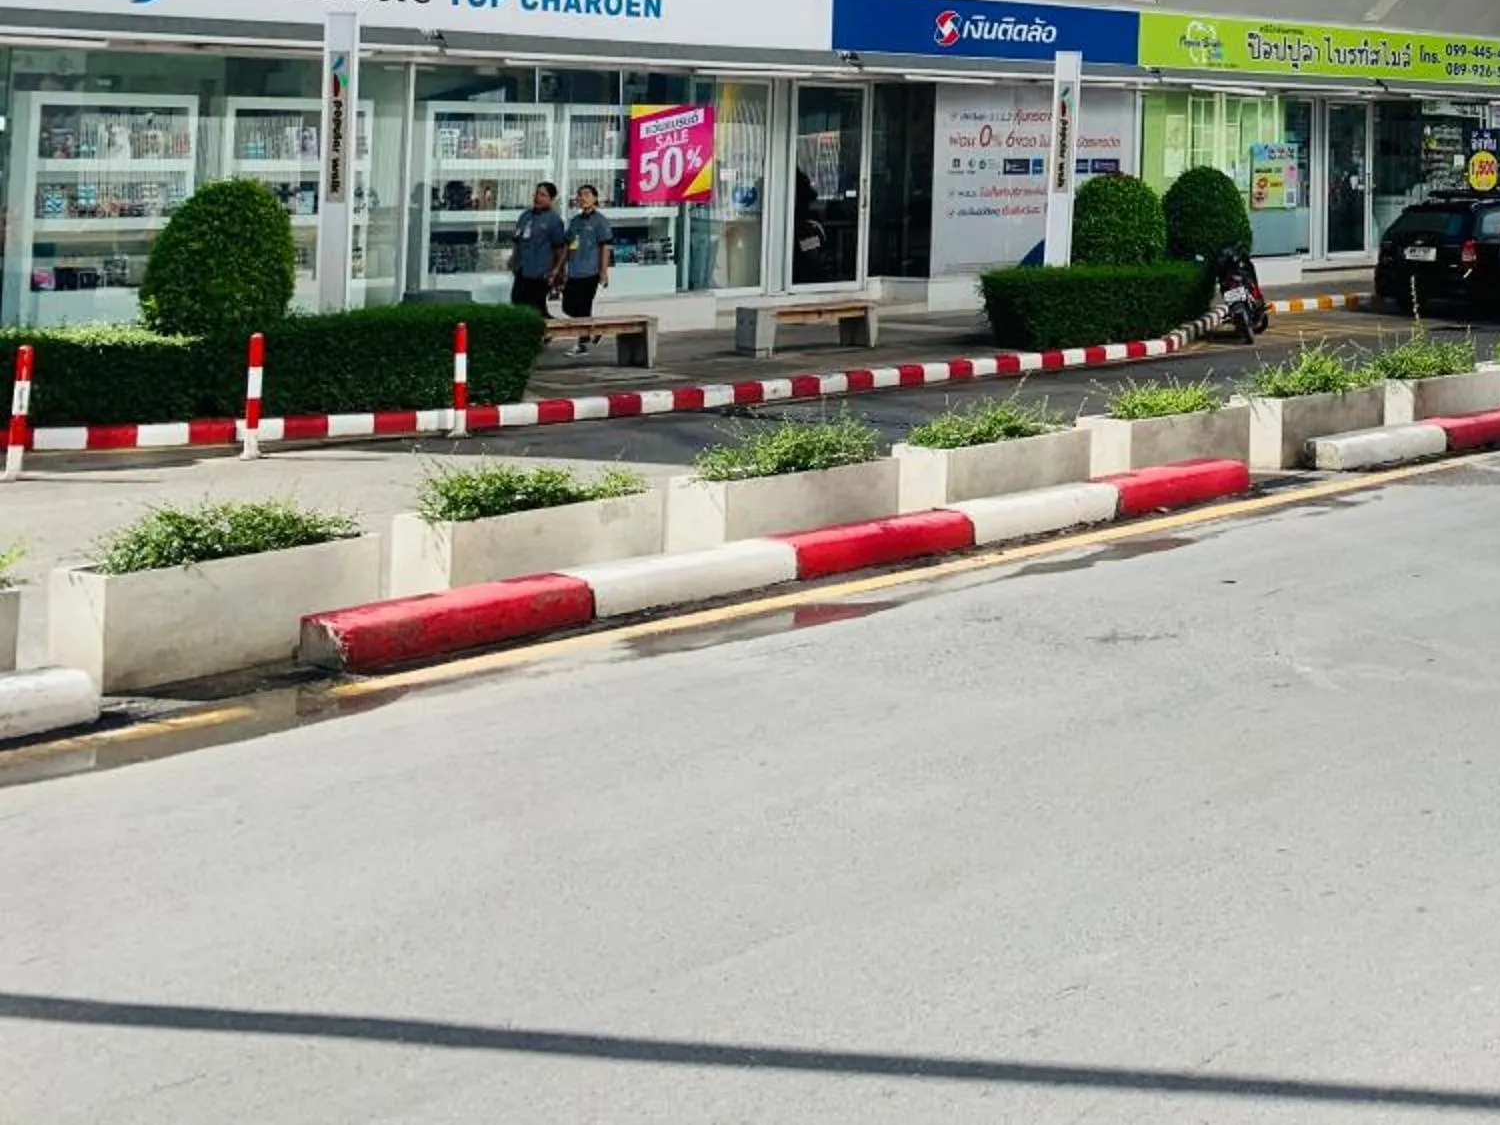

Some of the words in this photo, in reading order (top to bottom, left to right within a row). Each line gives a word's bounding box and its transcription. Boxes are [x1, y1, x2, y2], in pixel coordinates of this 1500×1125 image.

[962, 15, 1057, 43] เงินติดล้อ
[656, 128, 690, 151] SALE
